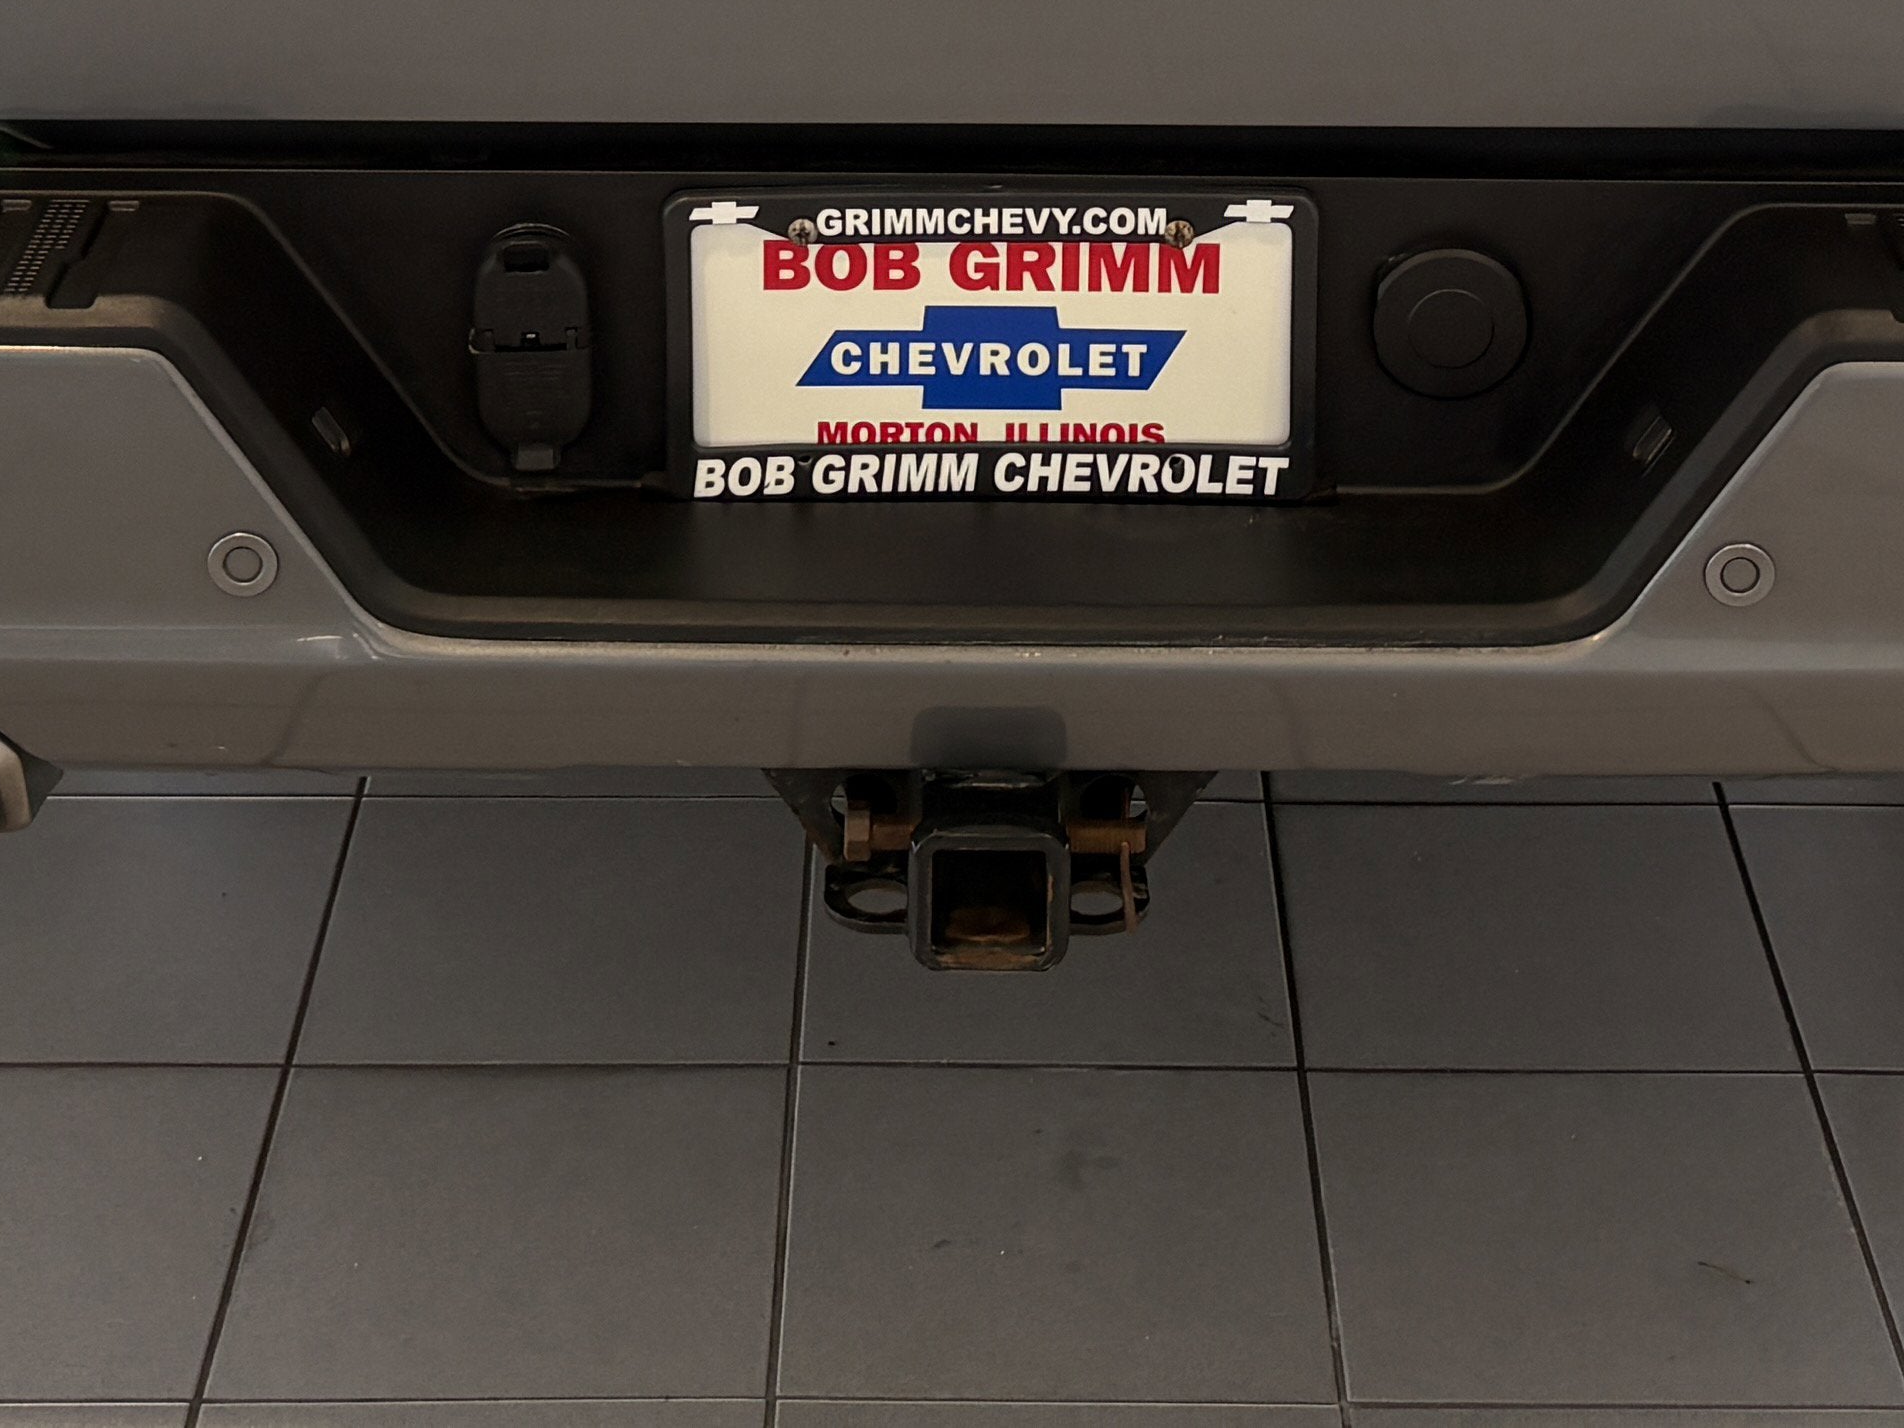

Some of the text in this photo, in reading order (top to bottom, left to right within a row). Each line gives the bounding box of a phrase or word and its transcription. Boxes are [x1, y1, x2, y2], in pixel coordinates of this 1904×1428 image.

[816, 207, 1167, 237] GRIMMCHEVY.COM
[763, 240, 1220, 295] BOB GRIMM
[830, 341, 1148, 377] CHEVROLET
[694, 453, 1290, 499] BOB GRIMM CHEVROLET
